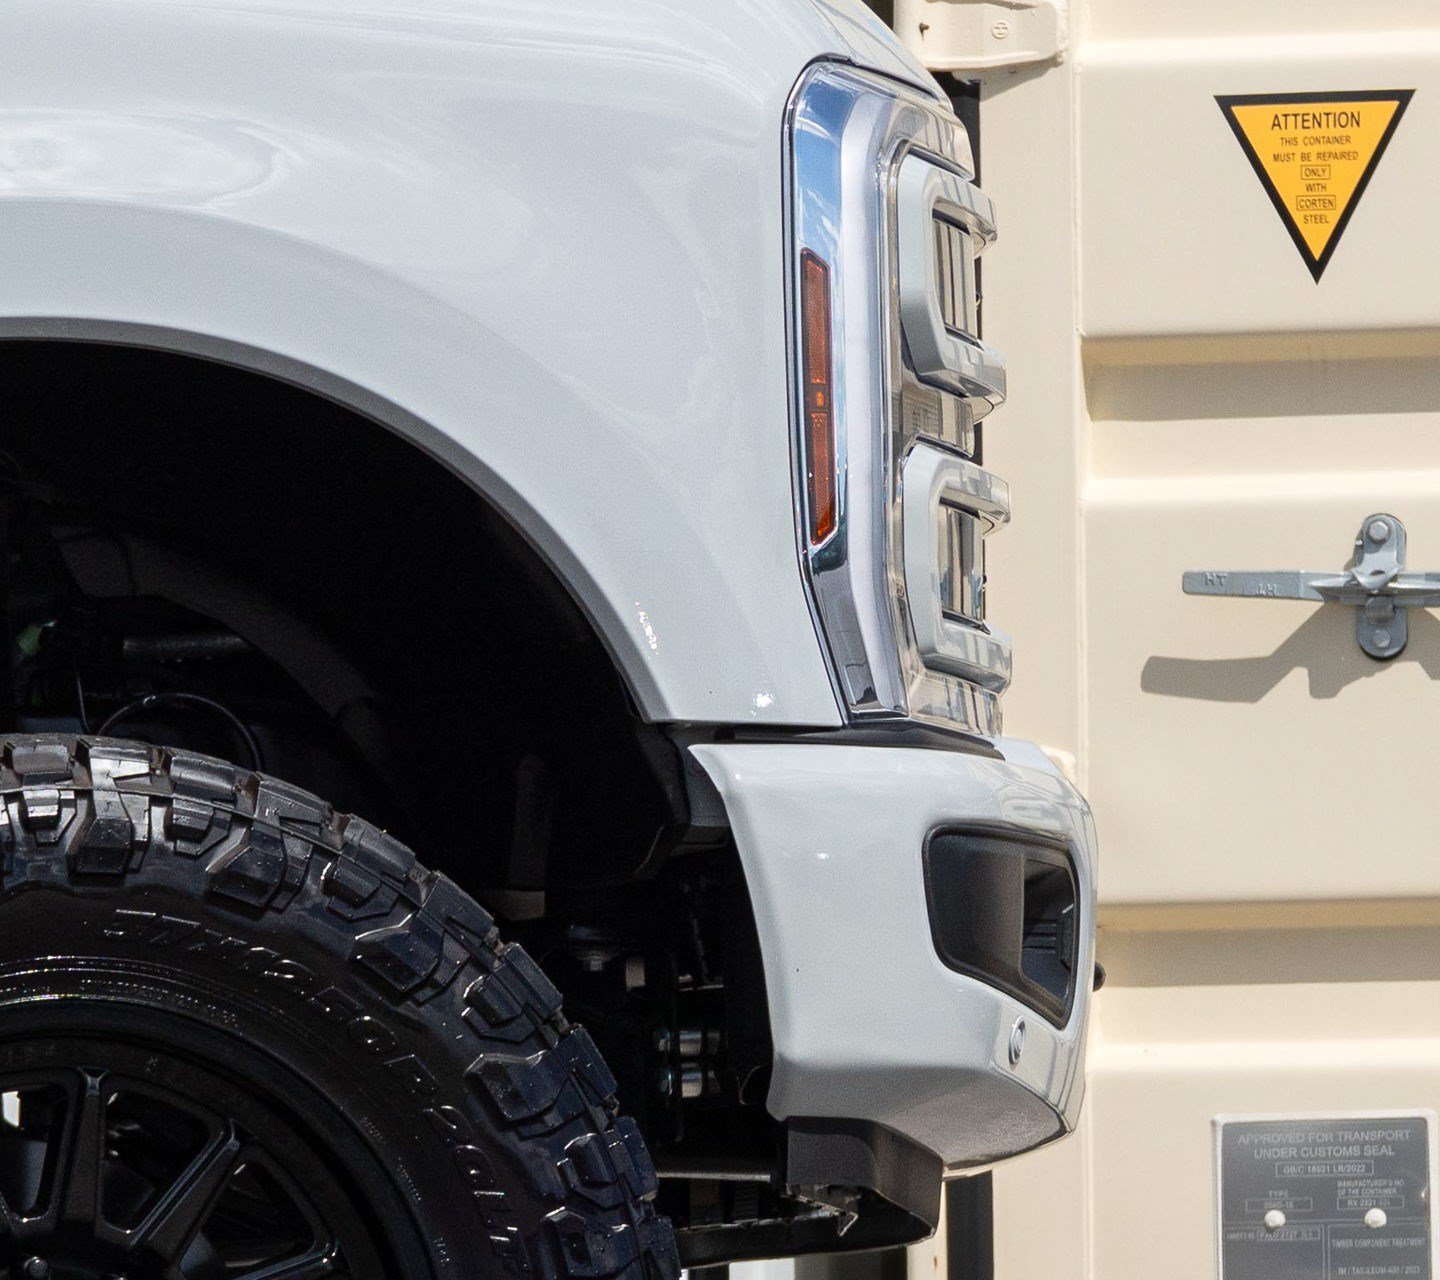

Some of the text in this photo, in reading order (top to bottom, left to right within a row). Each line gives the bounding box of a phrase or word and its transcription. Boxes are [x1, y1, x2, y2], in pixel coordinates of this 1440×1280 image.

[1271, 111, 1361, 130] ATTENTION
[1280, 135, 1352, 147] THIS CONTAINER
[1273, 151, 1359, 163] MUST BE REPAIRED
[1304, 167, 1327, 177] ONLY
[1305, 183, 1327, 193] WITH
[1298, 198, 1334, 209] CORTEN
[1303, 214, 1329, 224] STEEL
[1238, 1129, 1411, 1145] APPROVED FOR TRANSPORT
[1254, 1145, 1395, 1159] UNDER CUSTOMS SEAL
